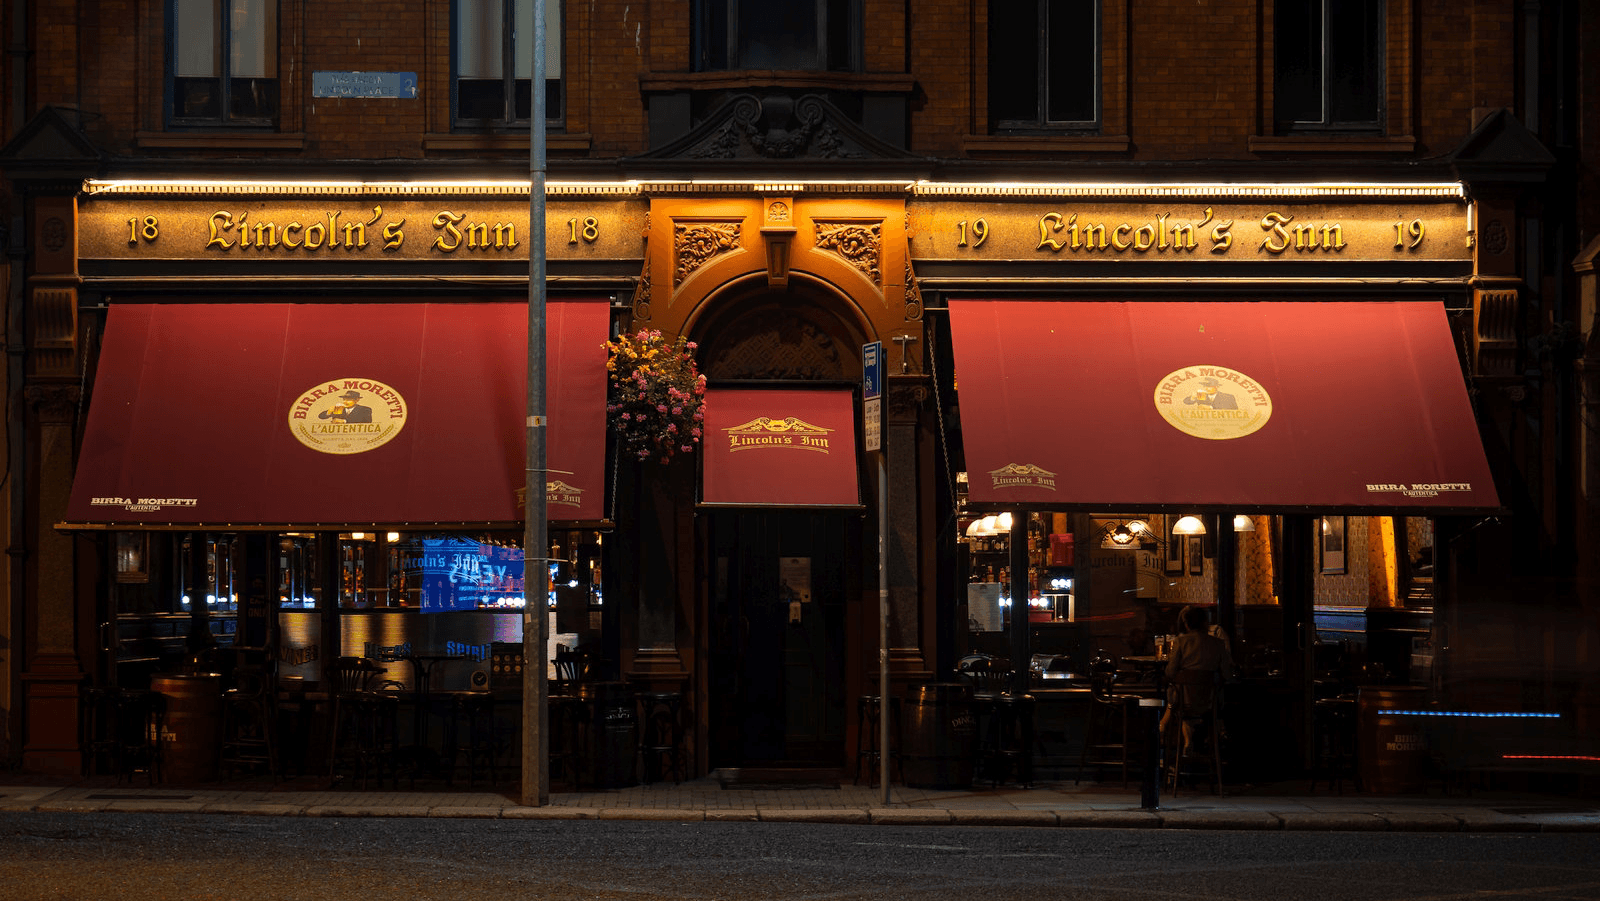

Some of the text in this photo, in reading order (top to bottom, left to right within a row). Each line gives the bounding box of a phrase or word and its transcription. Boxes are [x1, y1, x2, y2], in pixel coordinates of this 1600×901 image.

[364, 86, 394, 95] PLACE
[405, 78, 413, 92] 2
[128, 205, 599, 252] 18 Lincoln's Inn 18
[957, 206, 1425, 253] 19 Lincoln's Inn 19
[1160, 368, 1268, 406] BIRRA MORETTI
[293, 381, 403, 419] BIRRA MORETTI
[1180, 409, 1250, 419] L'AUTENTICA
[311, 424, 382, 434] L'AUTENTICA
[728, 434, 829, 448] Lincoln's Inn
[992, 476, 1056, 486] Lincoln's Inn
[91, 497, 198, 506] BIRRA MORETTI
[562, 494, 581, 503] Inn
[400, 553, 447, 569] ncoln's
